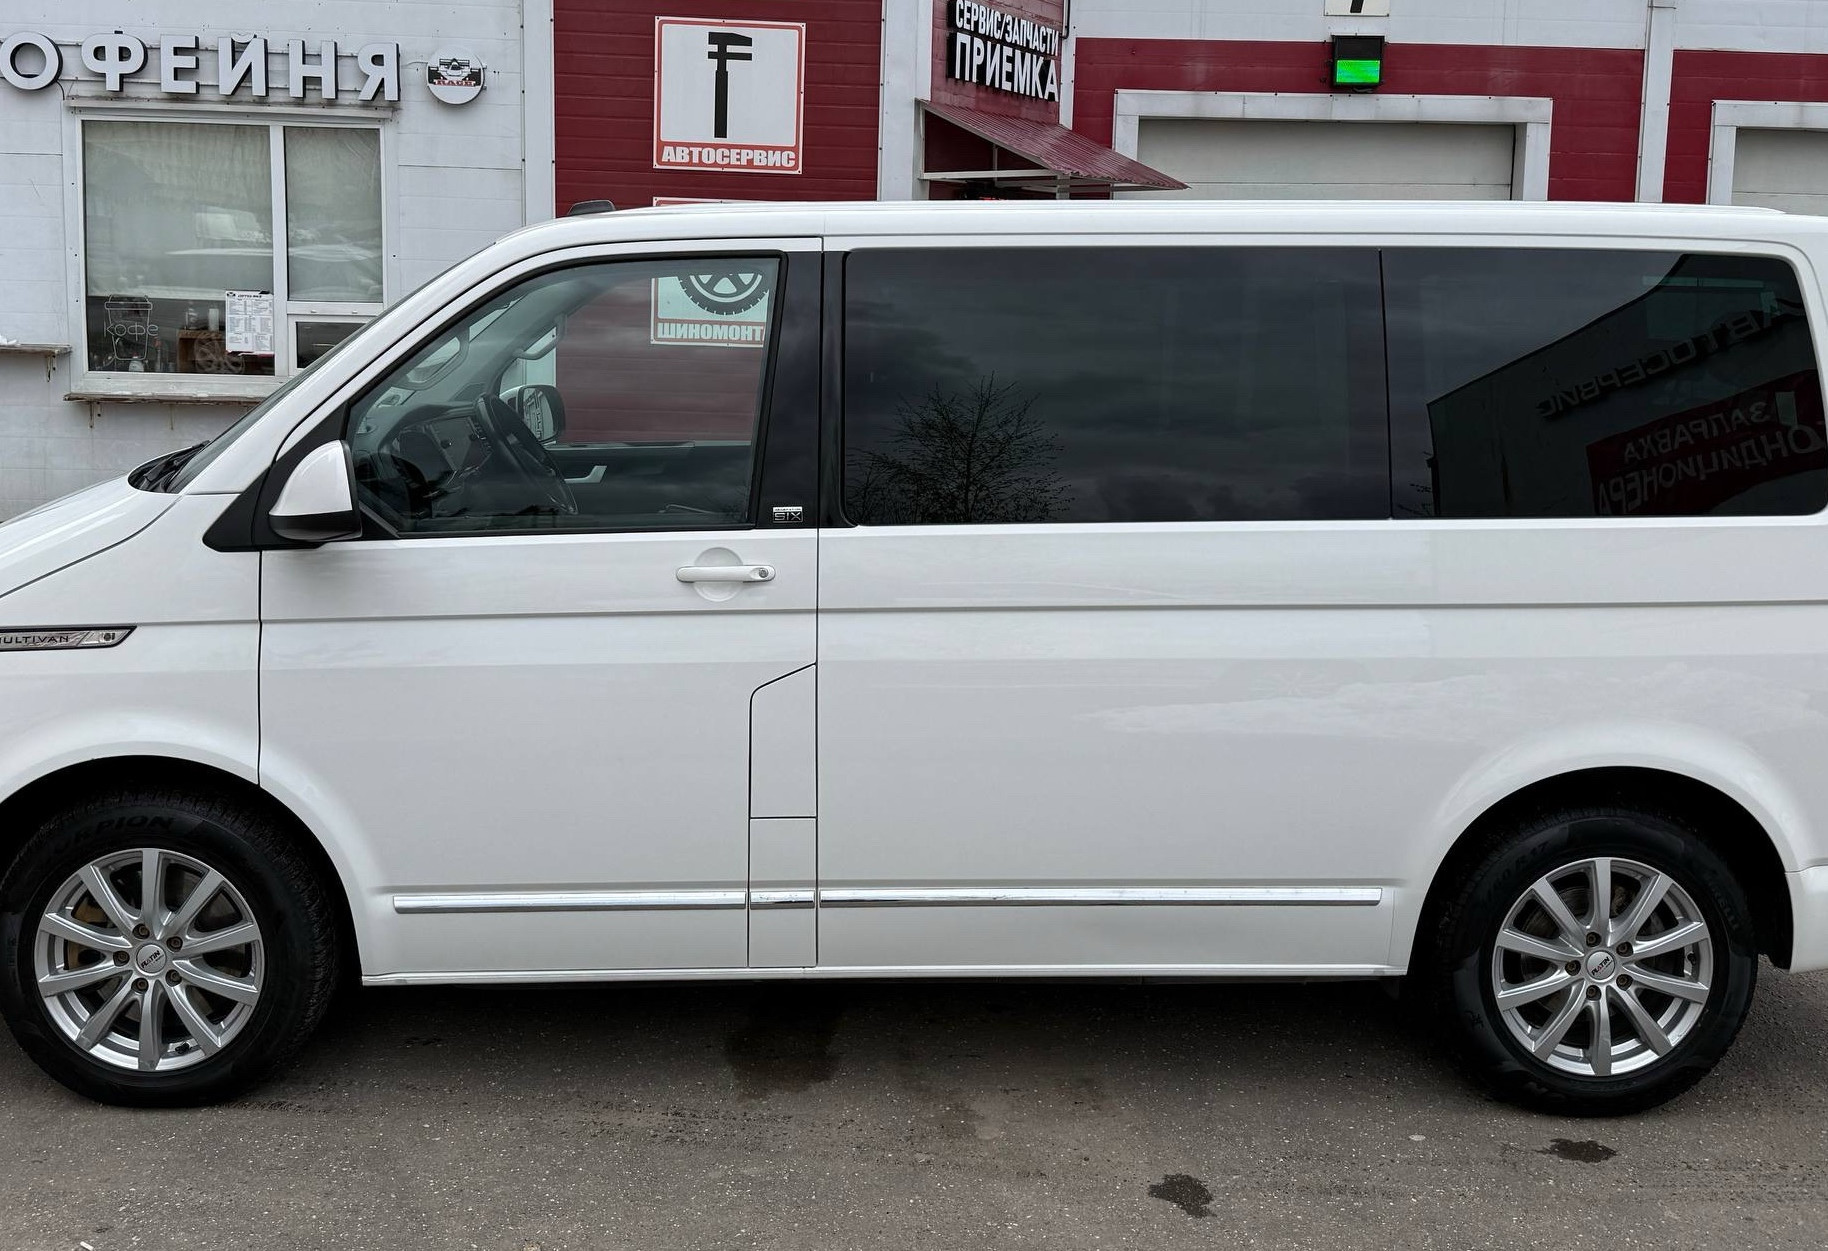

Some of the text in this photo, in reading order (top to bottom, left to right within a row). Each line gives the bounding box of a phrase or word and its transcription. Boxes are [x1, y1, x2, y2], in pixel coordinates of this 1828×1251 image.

[955, 0, 1059, 56] СЕРВИС/ЗАПЧАСТИ
[0, 31, 401, 101] ОФЕЙНЯ
[955, 32, 1060, 102] ПРИЕМКА
[661, 146, 796, 167] АВТОСЕРВИС
[104, 321, 158, 341] кофе
[657, 322, 765, 341] ШИНОМОНТ
[775, 512, 800, 520] SIX
[0, 635, 69, 644] ULTIVAN
[1591, 956, 1610, 975] PLATIN
